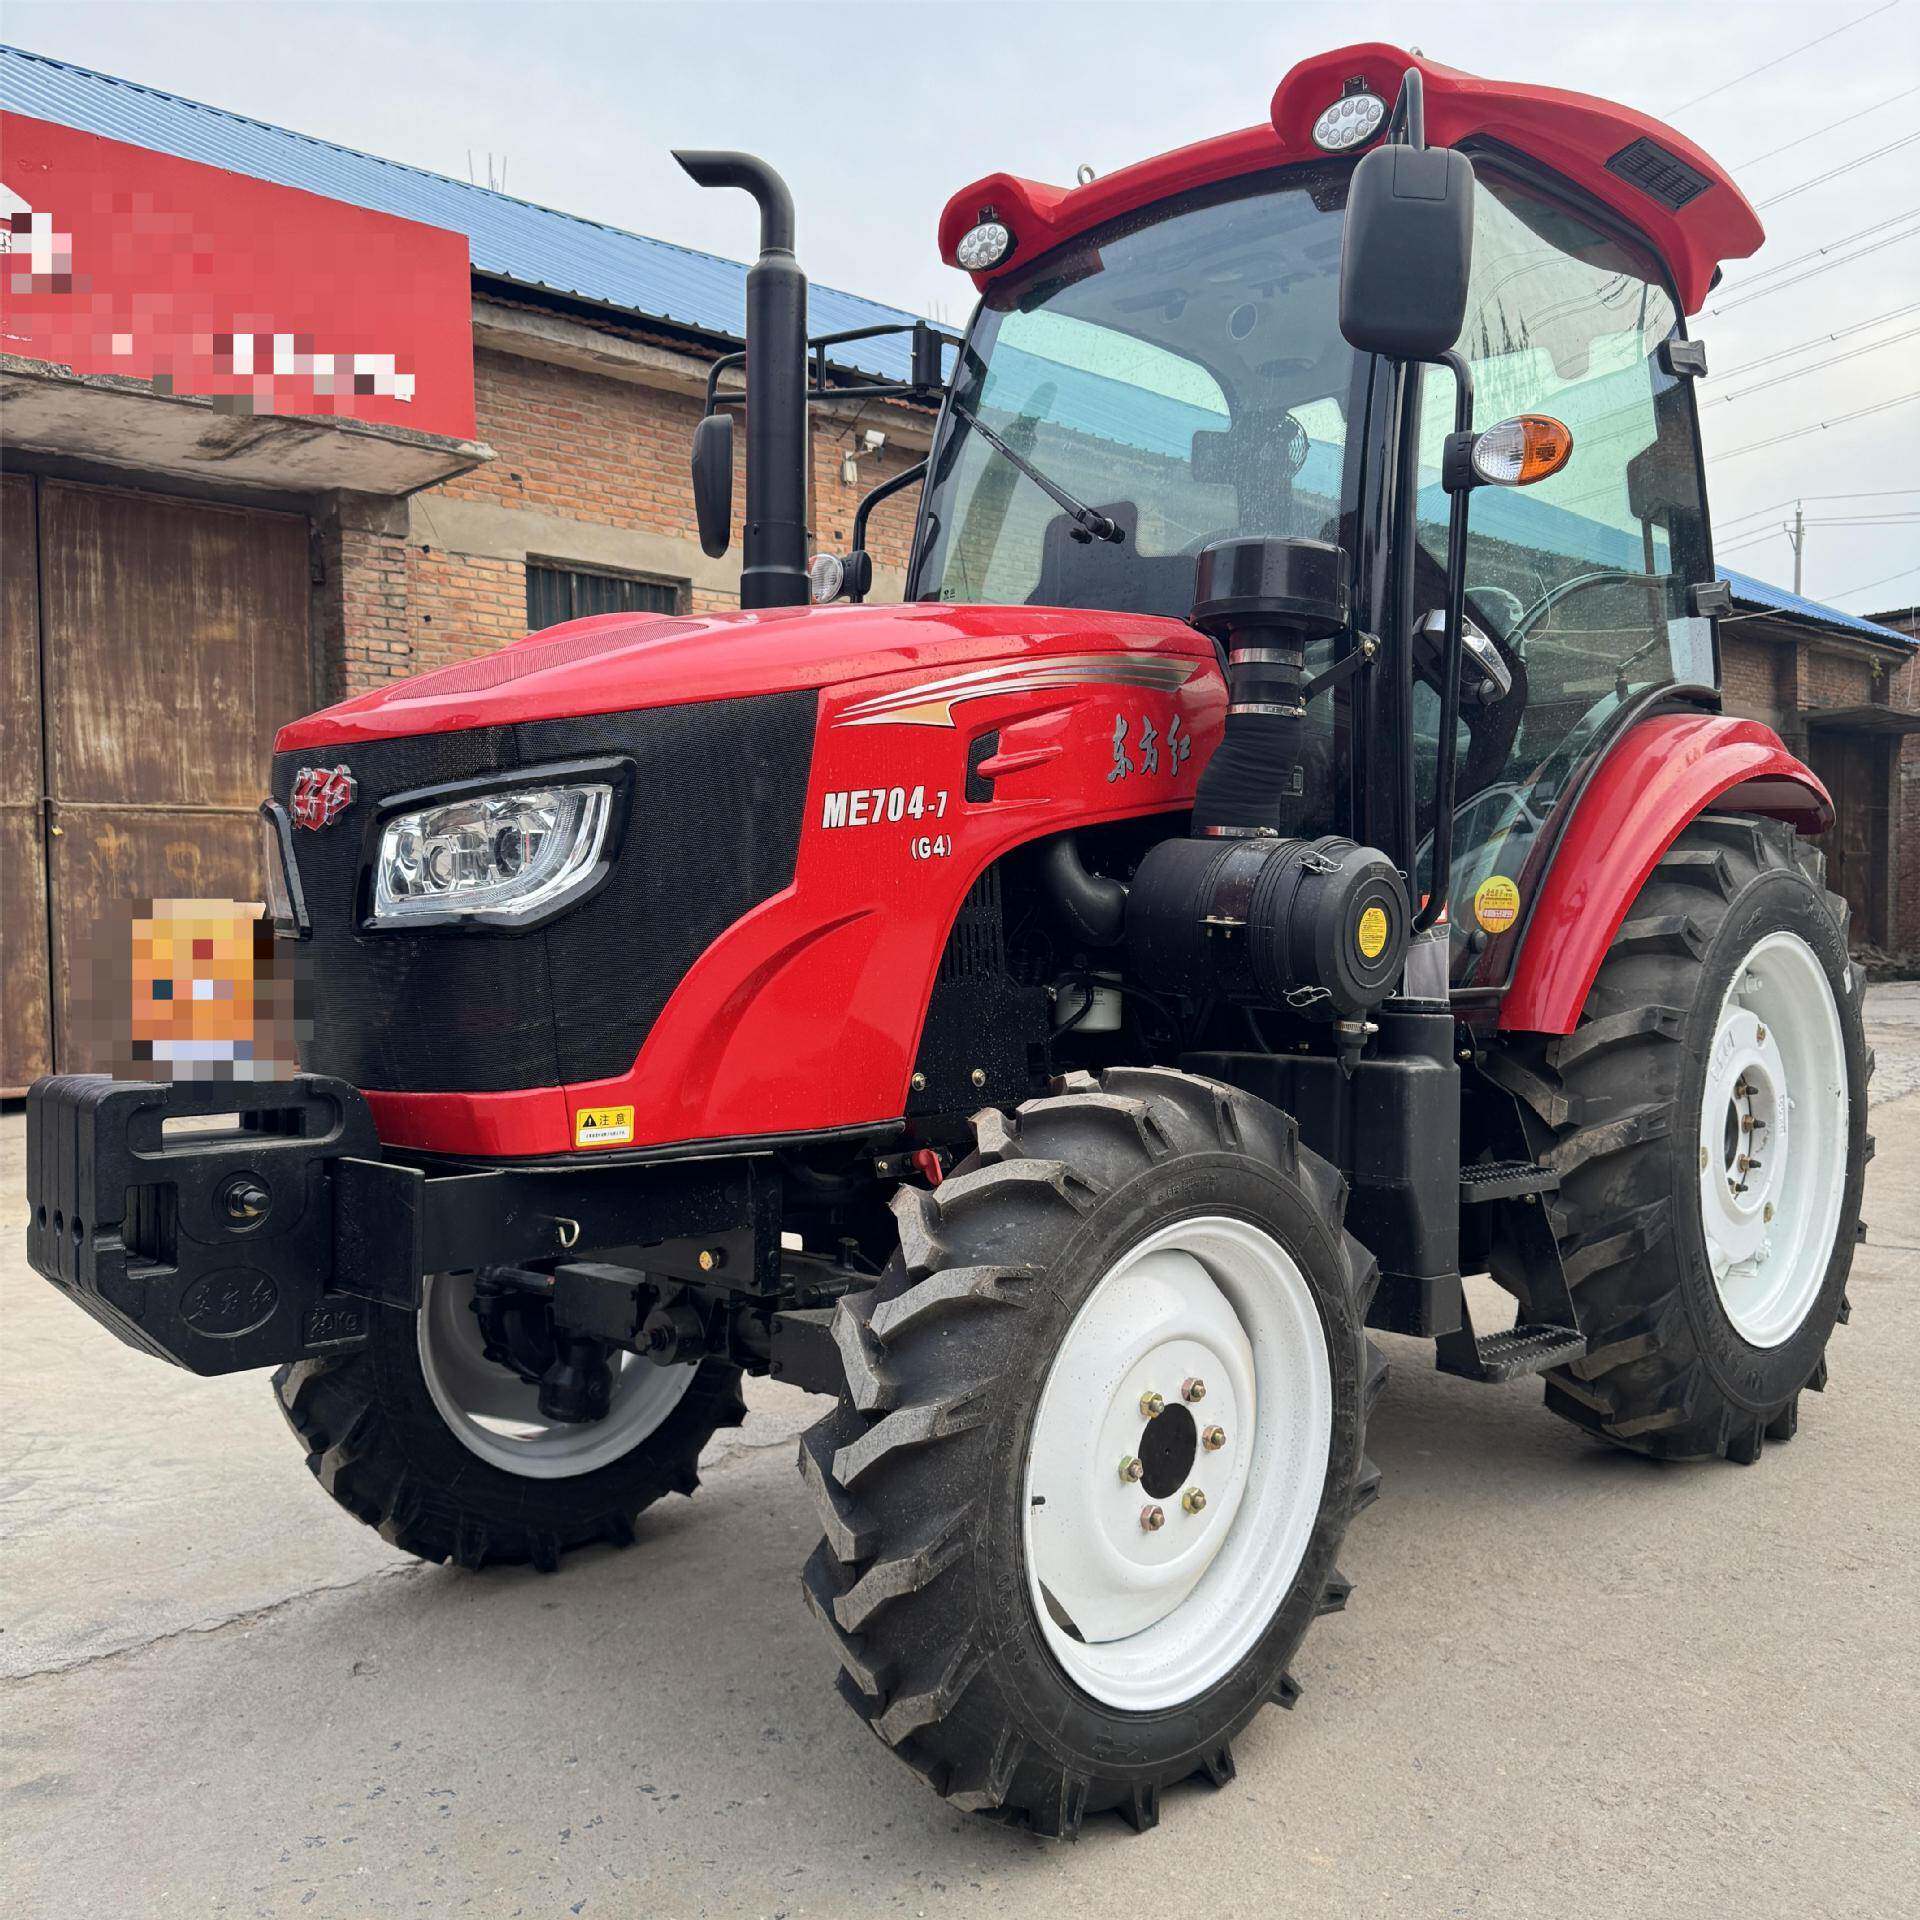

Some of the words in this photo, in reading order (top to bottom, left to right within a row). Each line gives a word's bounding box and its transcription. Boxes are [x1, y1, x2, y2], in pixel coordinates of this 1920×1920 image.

[1107, 713, 1191, 783] 东方红
[822, 785, 948, 829] ME704-7
[910, 834, 952, 860] (G4)
[599, 1112, 626, 1126] 注意
